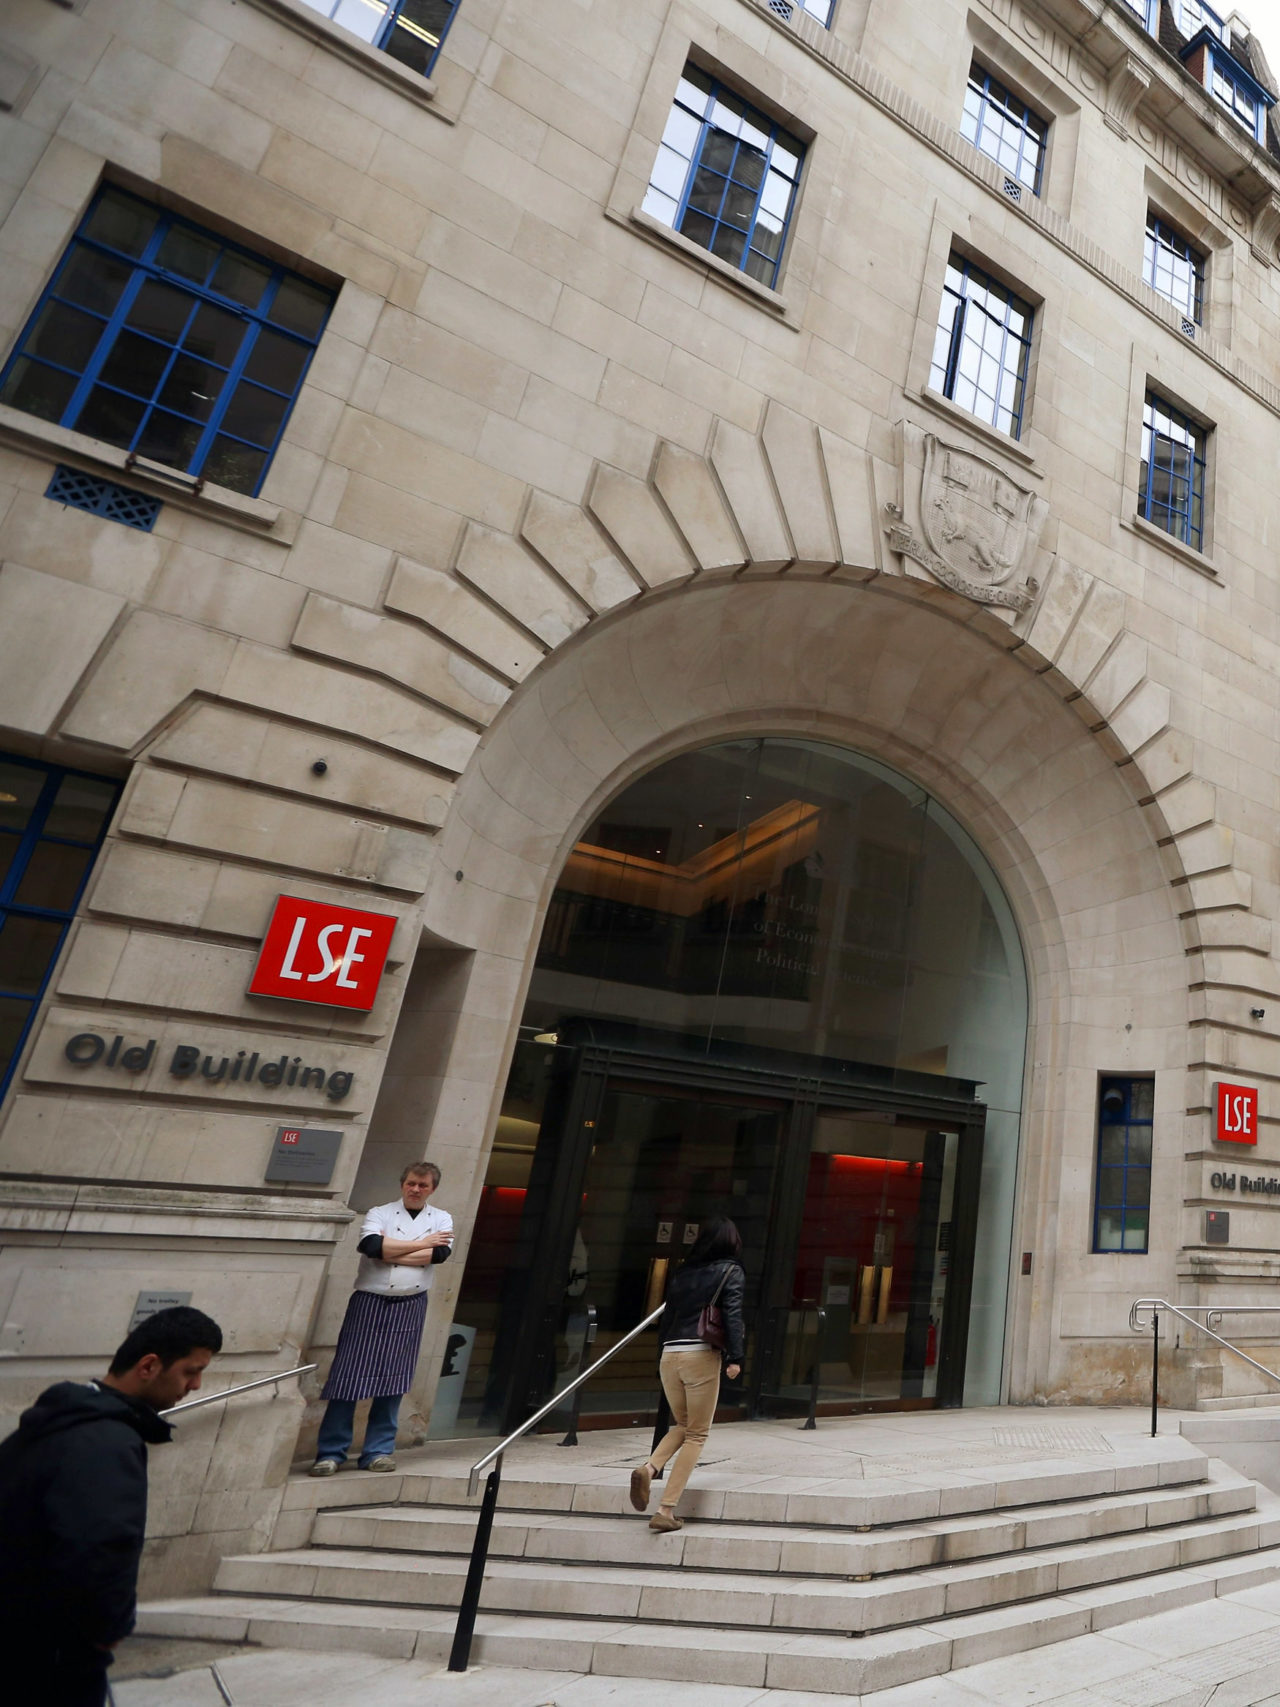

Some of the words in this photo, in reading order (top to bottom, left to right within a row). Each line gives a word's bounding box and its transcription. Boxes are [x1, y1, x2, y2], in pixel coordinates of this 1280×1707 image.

[279, 916, 372, 989] LSE
[756, 947, 821, 977] Political
[65, 1033, 157, 1072] Old
[169, 1045, 355, 1101] Building
[1224, 1093, 1252, 1134] LSE
[283, 1132, 298, 1143] LSE
[1210, 1172, 1236, 1191] Old
